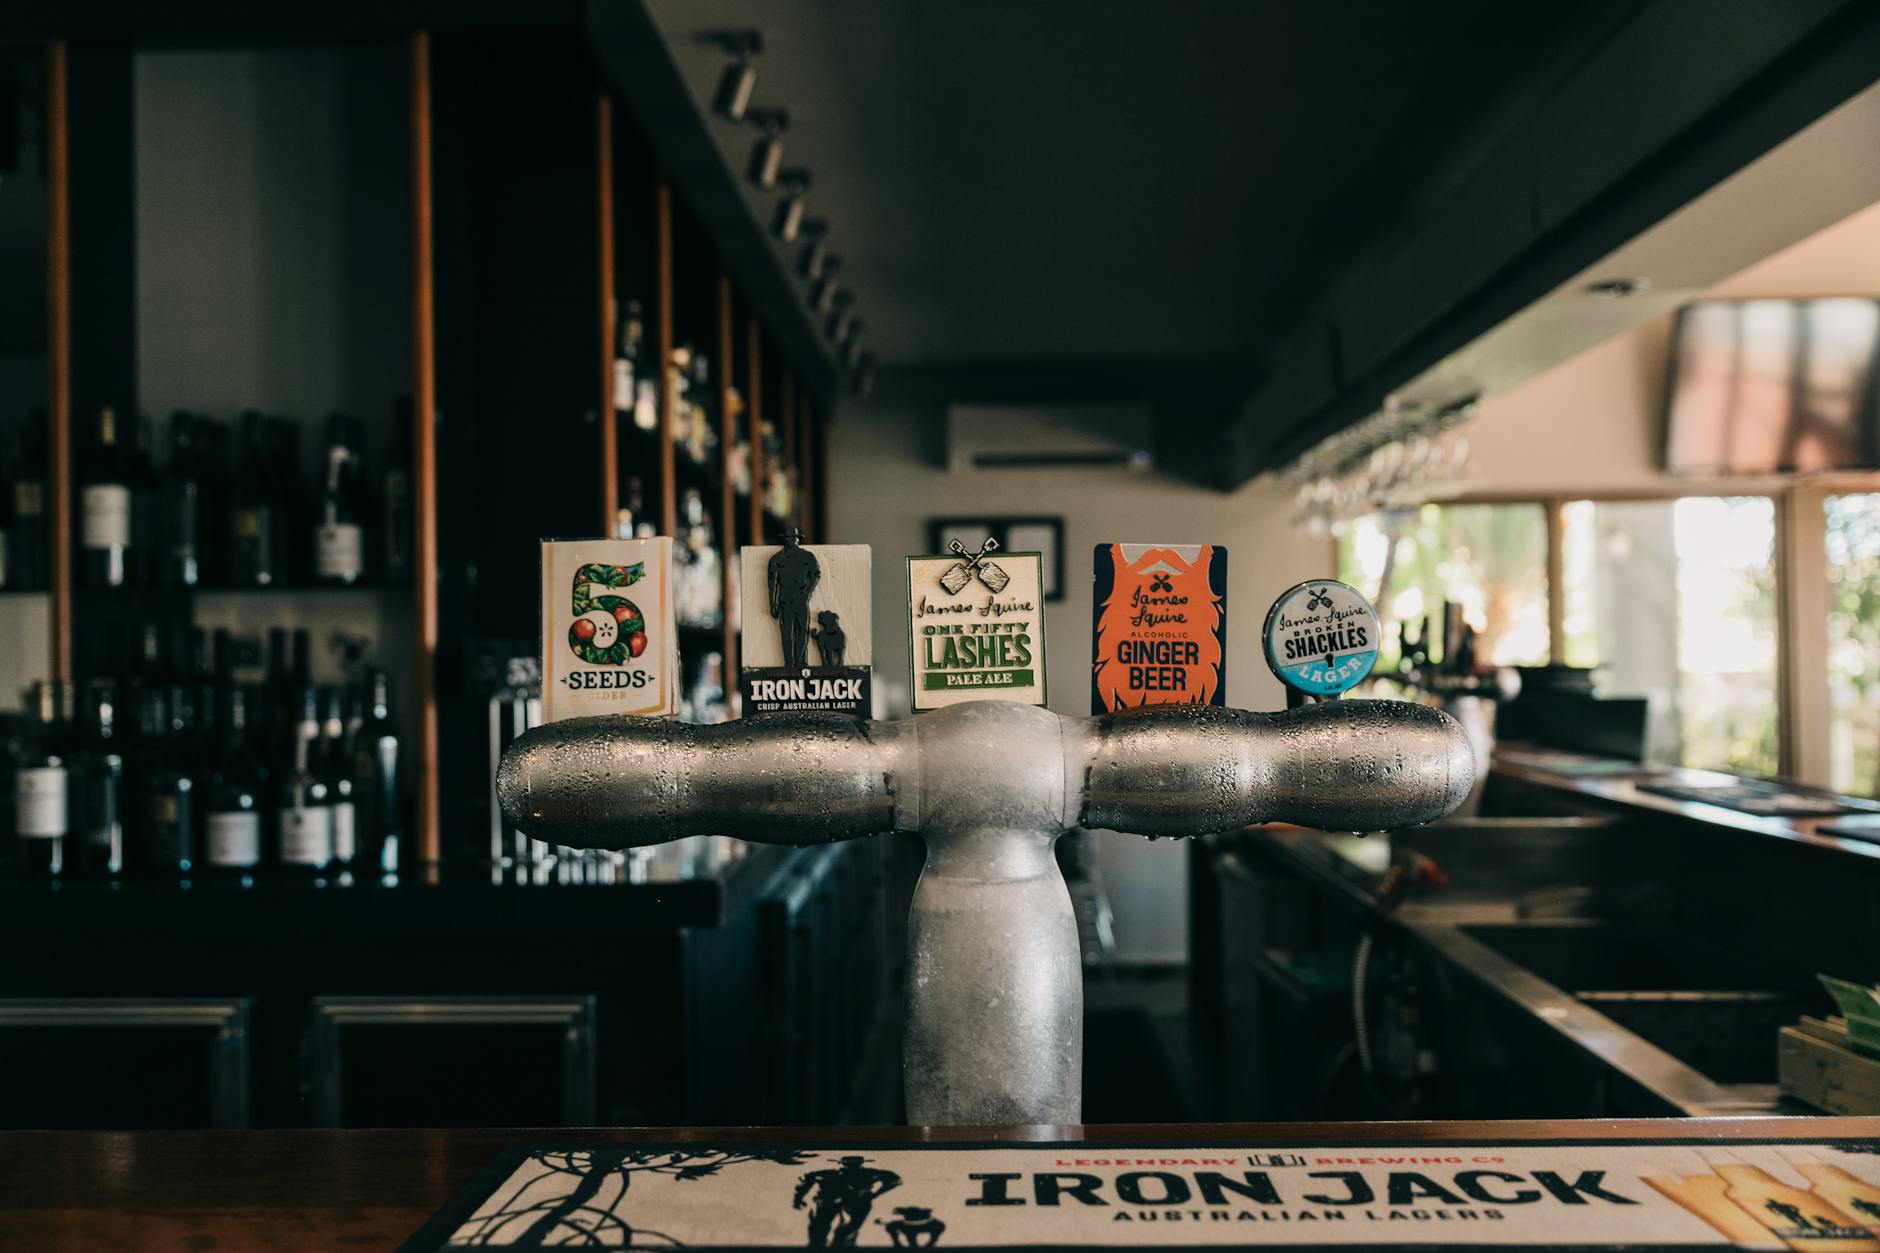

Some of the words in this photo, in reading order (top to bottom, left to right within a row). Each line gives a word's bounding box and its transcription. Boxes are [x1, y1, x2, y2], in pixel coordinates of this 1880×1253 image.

[916, 595, 973, 618] James
[978, 595, 1034, 616] Squire
[1131, 584, 1188, 608] James
[568, 561, 647, 666] 5
[1130, 605, 1188, 628] Squire
[1279, 613, 1320, 631] James
[1324, 605, 1367, 623] Squire
[922, 624, 963, 636] ONE
[970, 622, 1030, 635] FIFTY
[1130, 631, 1189, 639] ALCOHOLIC
[1293, 620, 1355, 637] BROKEN
[923, 633, 1032, 670] LASHES
[1117, 640, 1199, 665] GINGER
[1284, 626, 1368, 660] SHACKLES
[568, 670, 646, 689] SEEDS
[946, 673, 983, 686] PALE
[984, 672, 1013, 685] ALE
[1129, 667, 1187, 691] BEER
[1298, 657, 1361, 683] LAGER
[587, 691, 626, 700] CIDER
[750, 679, 805, 701] IRON
[806, 678, 863, 700] JACK
[757, 702, 780, 711] CRISP
[783, 701, 830, 710] AUSTRALIAN
[832, 701, 857, 709] LAGER
[1056, 1158, 1238, 1166] LEGENDARY
[1314, 1156, 1462, 1166] BREWING
[965, 1171, 1285, 1206] IRON
[1302, 1170, 1641, 1206] JACK
[1112, 1209, 1345, 1222] AUSTRALIAN
[1366, 1208, 1505, 1221] LAGERS
